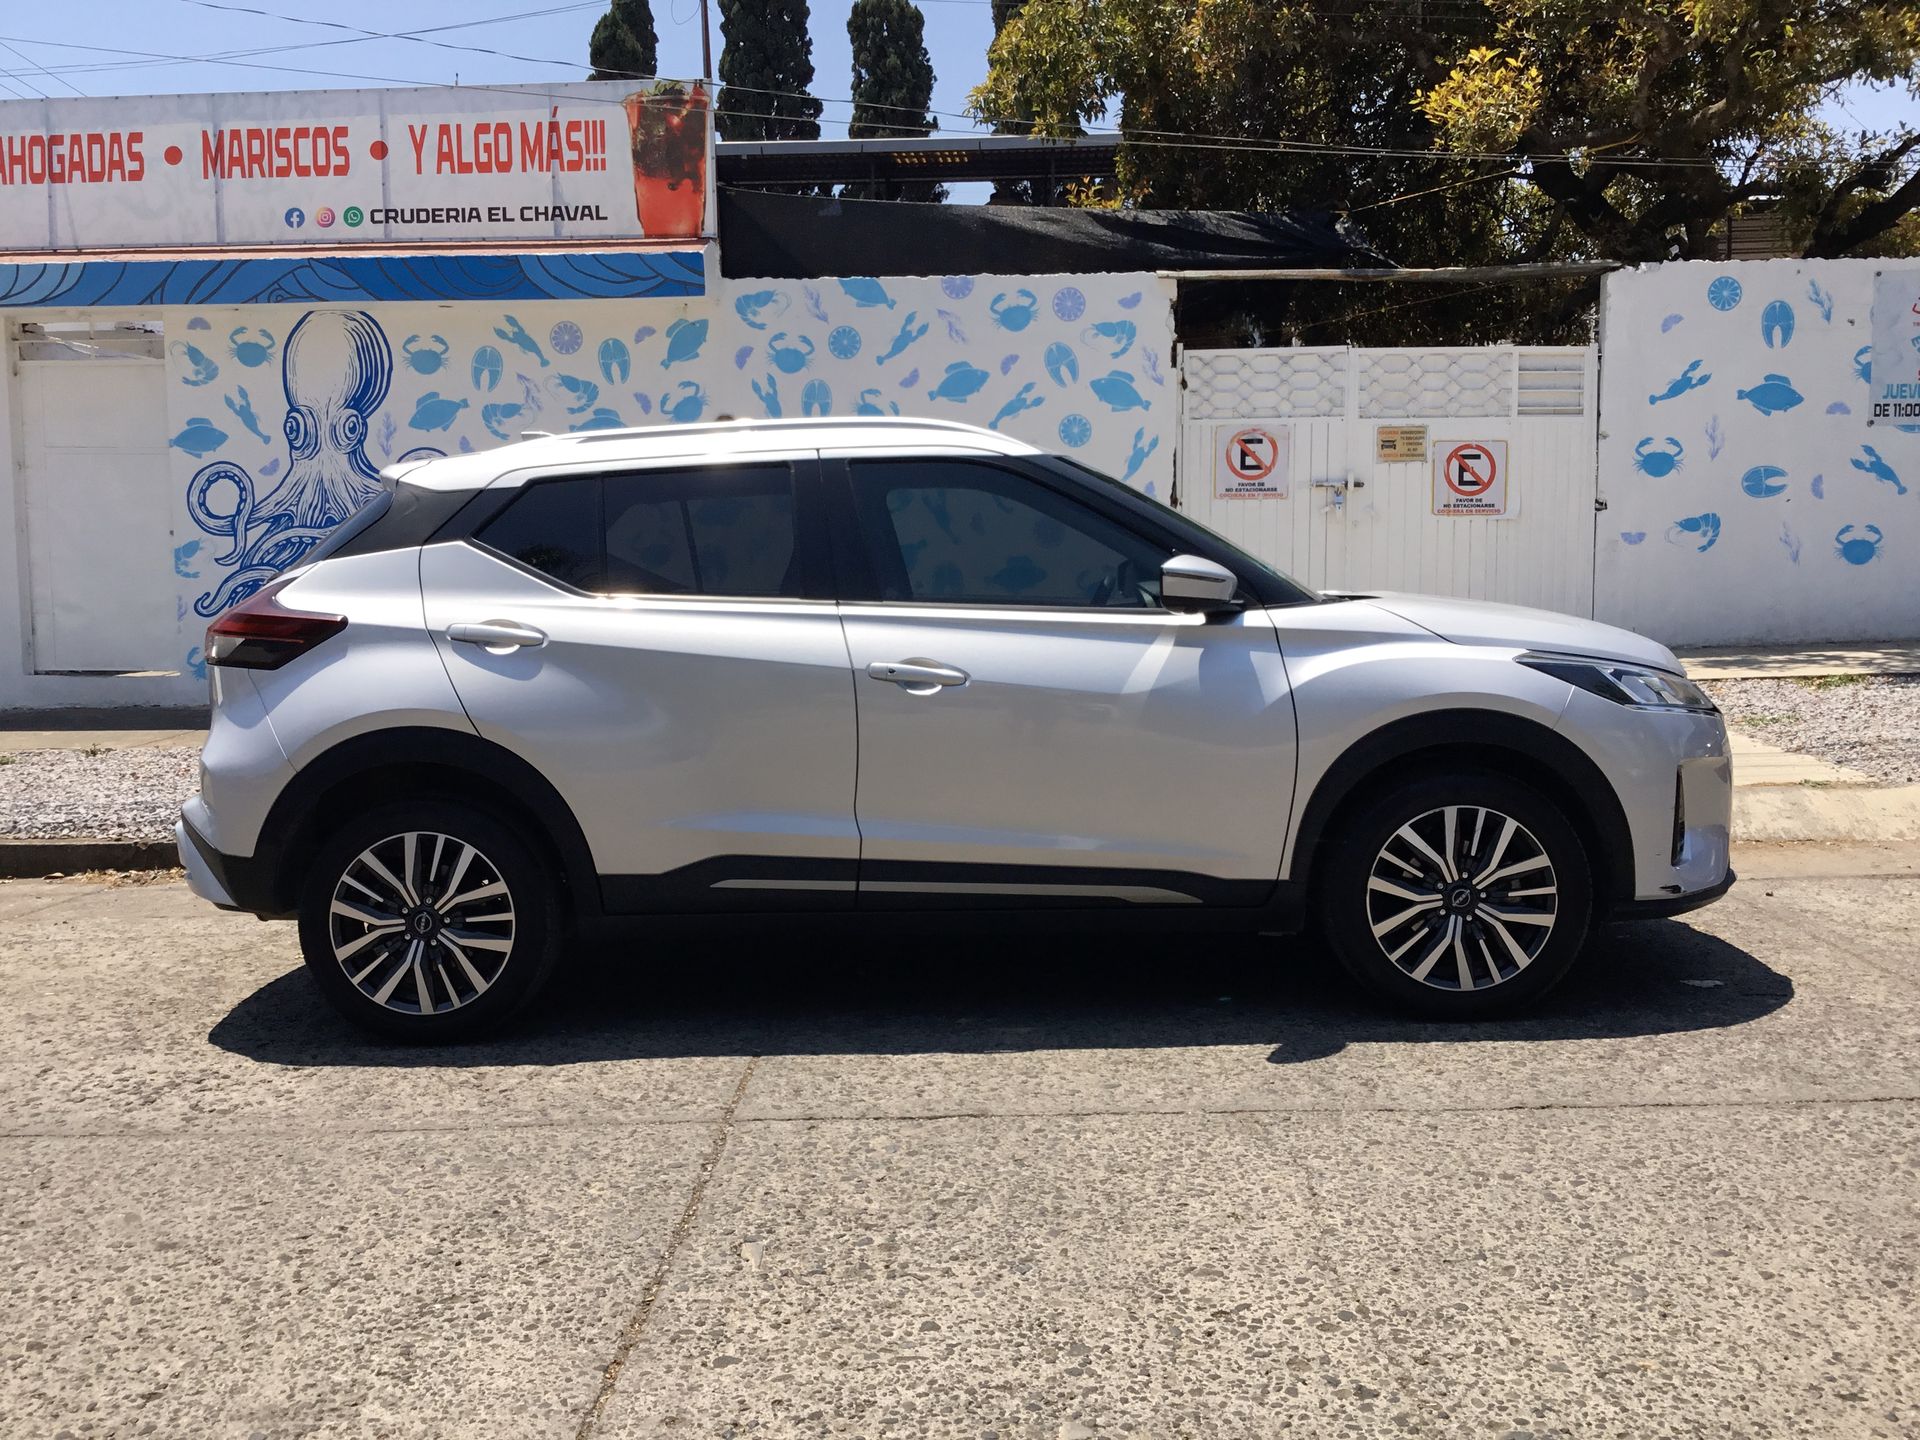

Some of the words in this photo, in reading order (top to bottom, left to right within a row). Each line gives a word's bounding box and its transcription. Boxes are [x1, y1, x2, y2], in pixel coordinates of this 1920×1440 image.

[202, 126, 350, 180] MARISCOS
[408, 124, 428, 175] Y
[436, 122, 513, 175] ALGO
[520, 105, 607, 173] MÁS!!!
[370, 207, 482, 225] CRUDERIA
[487, 207, 515, 222] EL
[519, 205, 608, 222] CHAVAL
[1874, 404, 1890, 417] DE
[1894, 404, 1920, 417] 11:00
